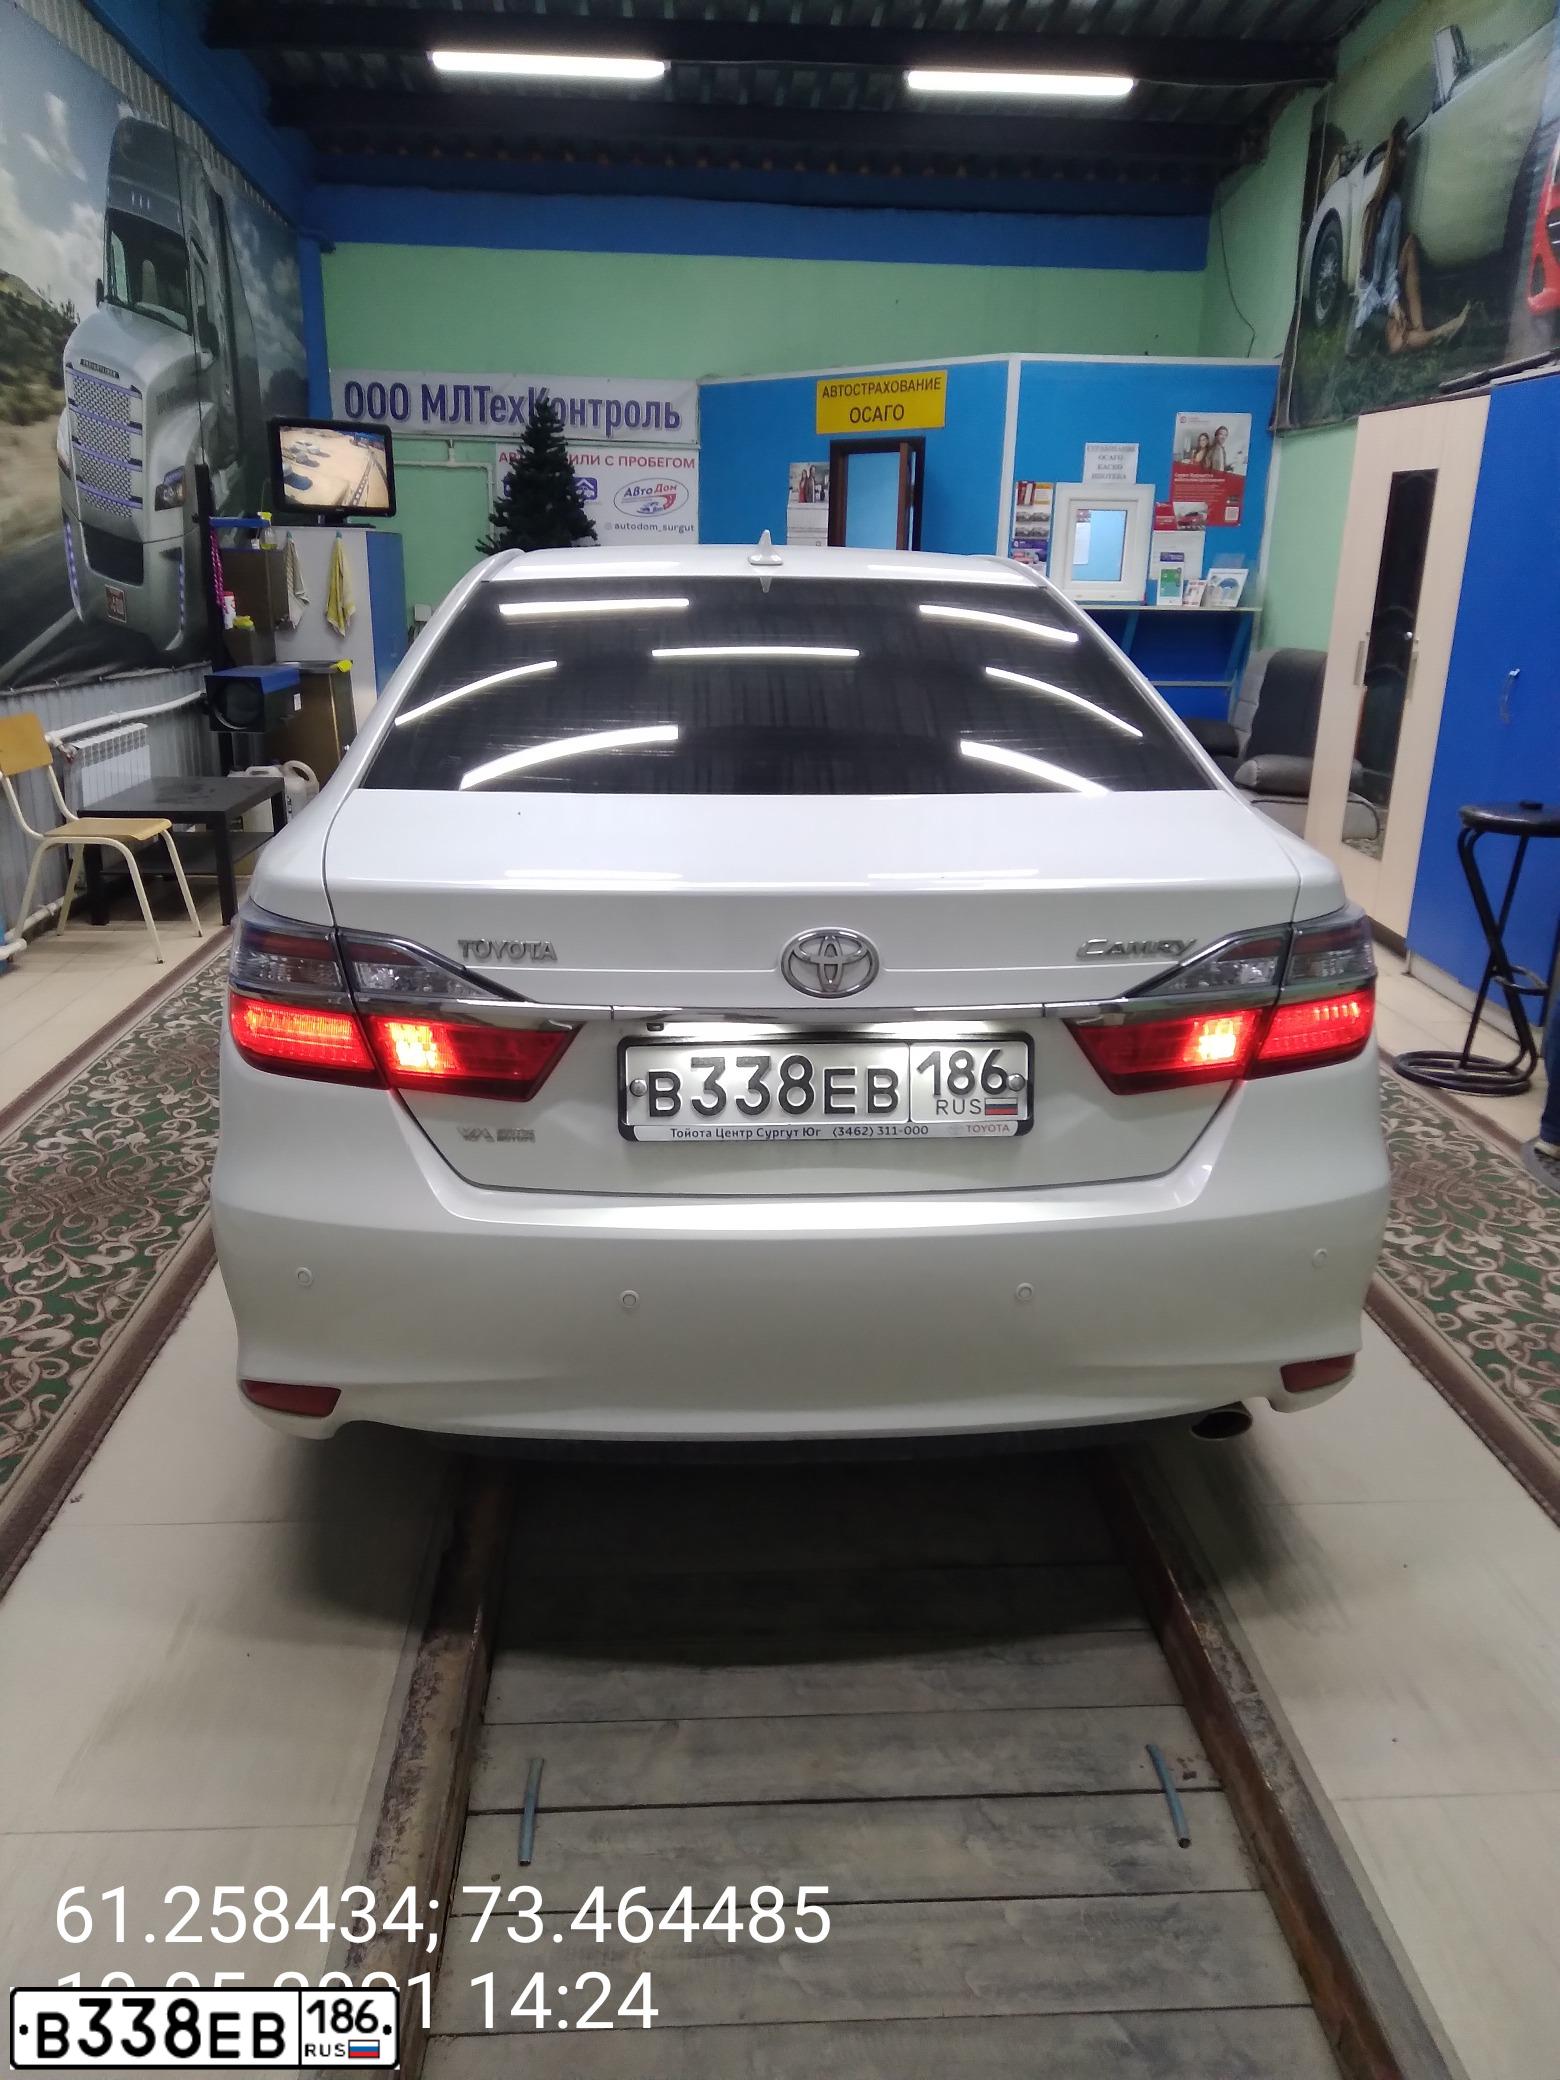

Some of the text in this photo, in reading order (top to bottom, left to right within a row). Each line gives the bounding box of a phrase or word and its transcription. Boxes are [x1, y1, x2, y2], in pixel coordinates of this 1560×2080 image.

[822, 377, 942, 399] АВТОСТРАХОВАНИЕ
[345, 381, 683, 439] ООО МЛТехКонтроль
[850, 404, 905, 424] ОСАГО
[499, 452, 696, 469] АВИЛИ С ПРОБЕГОМ
[457, 939, 558, 962] TOYOTA
[648, 1049, 1009, 1117] В338ЕВ 186
[936, 1099, 982, 1115] RUS
[670, 1125, 929, 1140] Тойота Центр Сургут Юг (3462) 311-000
[966, 1124, 1010, 1133] TOYOTA
